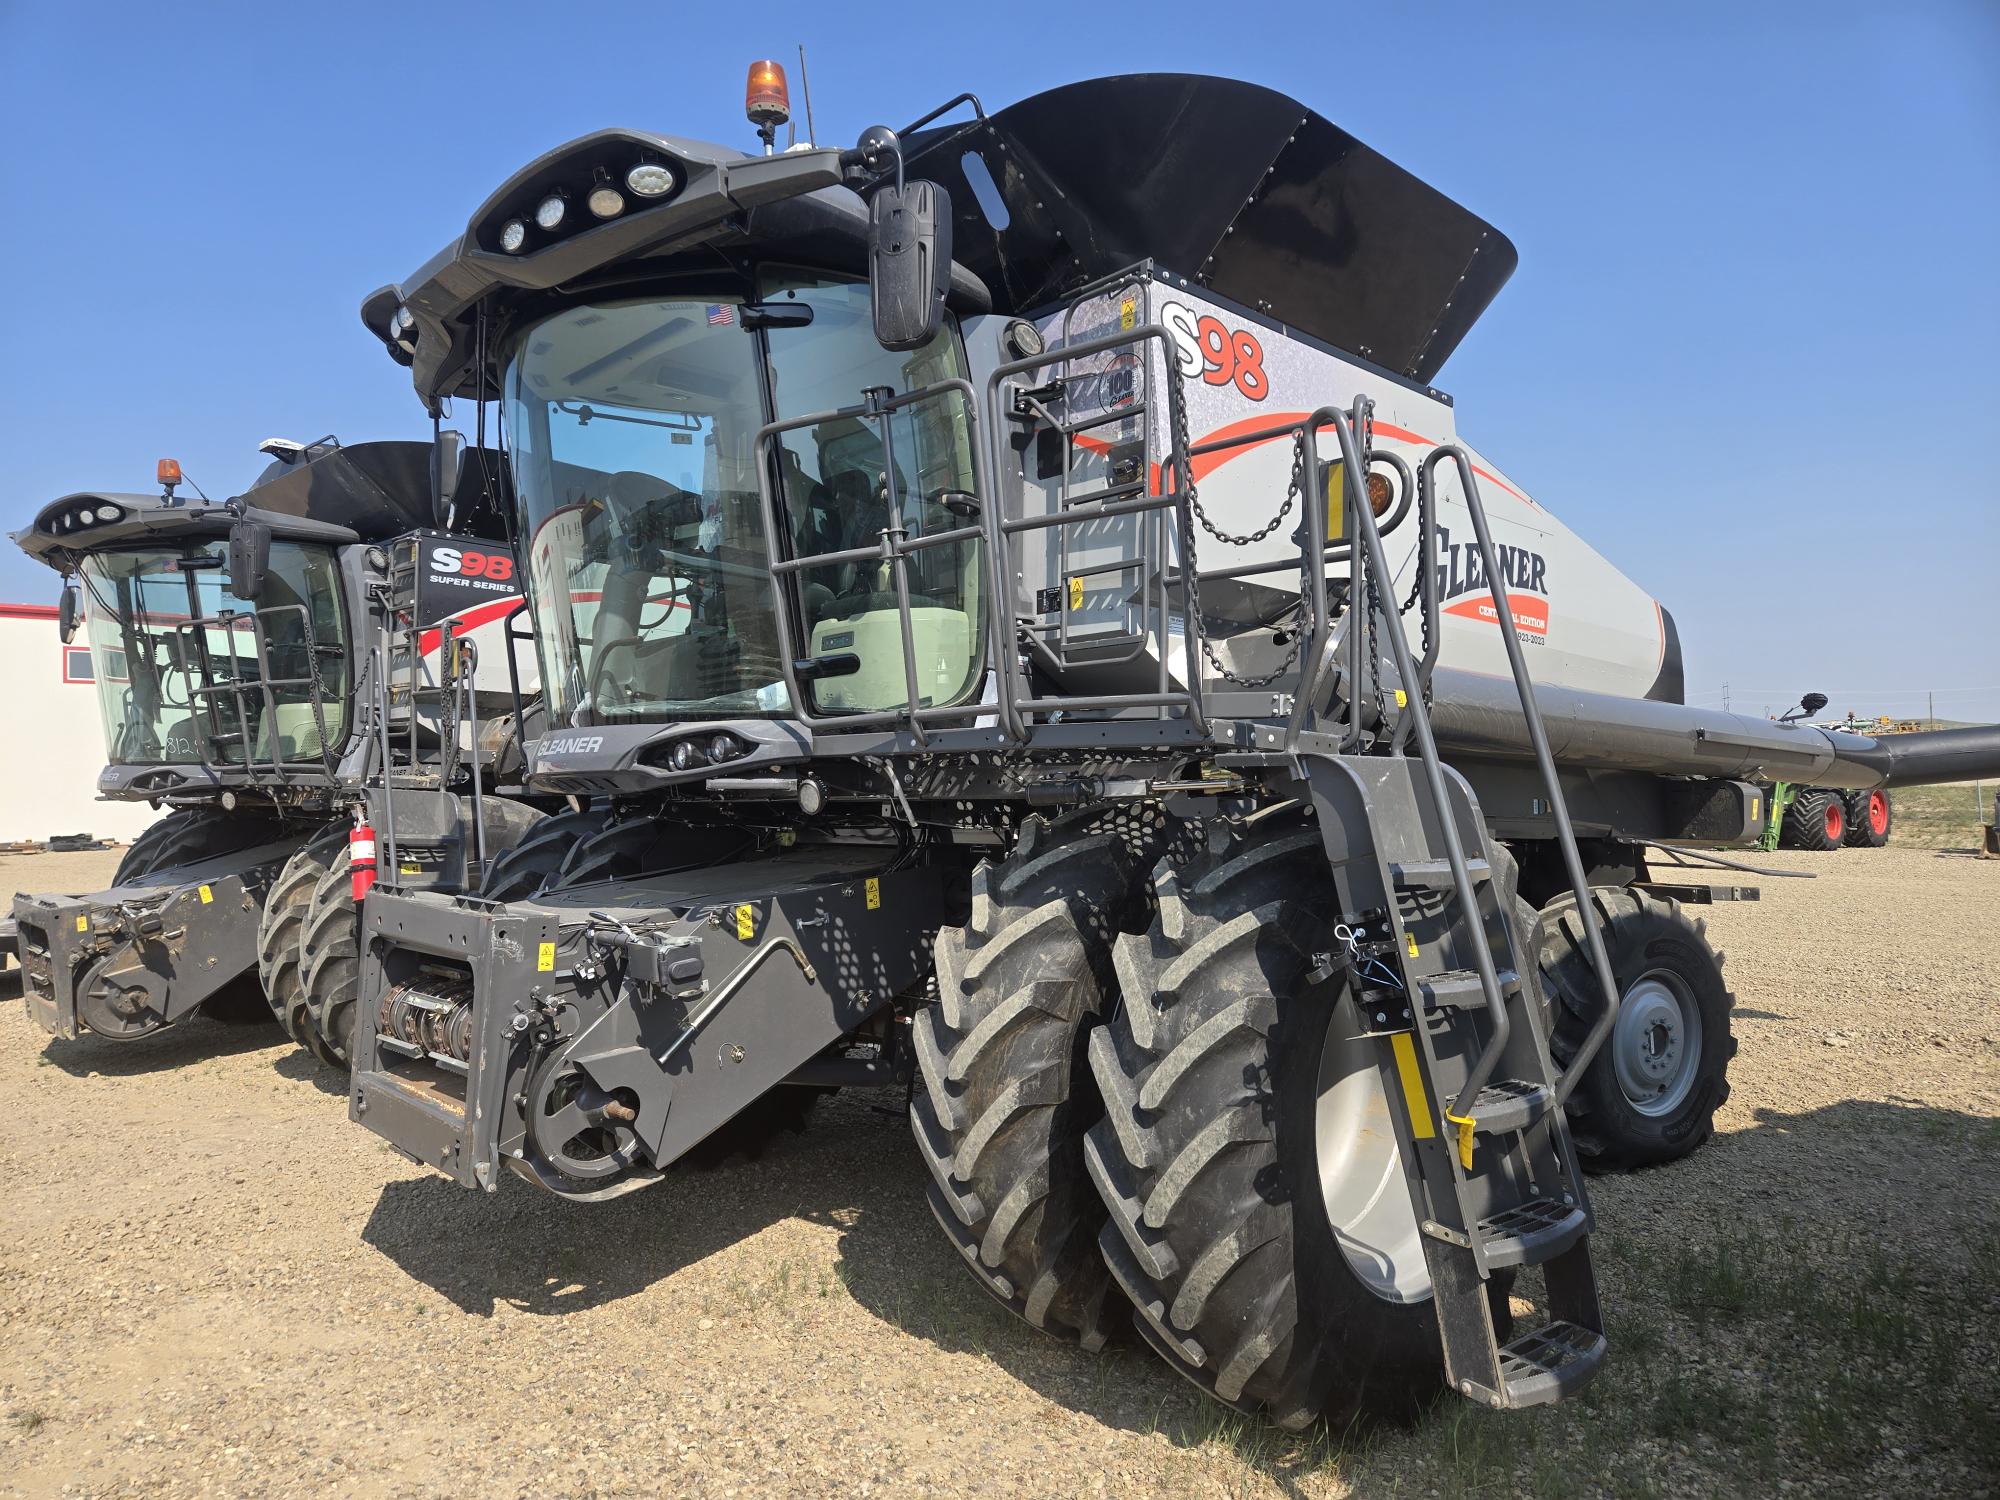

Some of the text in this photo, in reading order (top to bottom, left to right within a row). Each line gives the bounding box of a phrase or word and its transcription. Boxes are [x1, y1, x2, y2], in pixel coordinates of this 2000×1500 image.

[1161, 301, 1269, 402] S98
[1107, 370, 1133, 396] 100
[431, 547, 513, 580] S98
[1419, 523, 1548, 604] GLENER
[430, 575, 515, 593] SUPER SERIES
[1478, 605, 1545, 629] CENTAL EDITION
[1516, 632, 1545, 646] 923-2023
[537, 736, 604, 757] GLEANER
